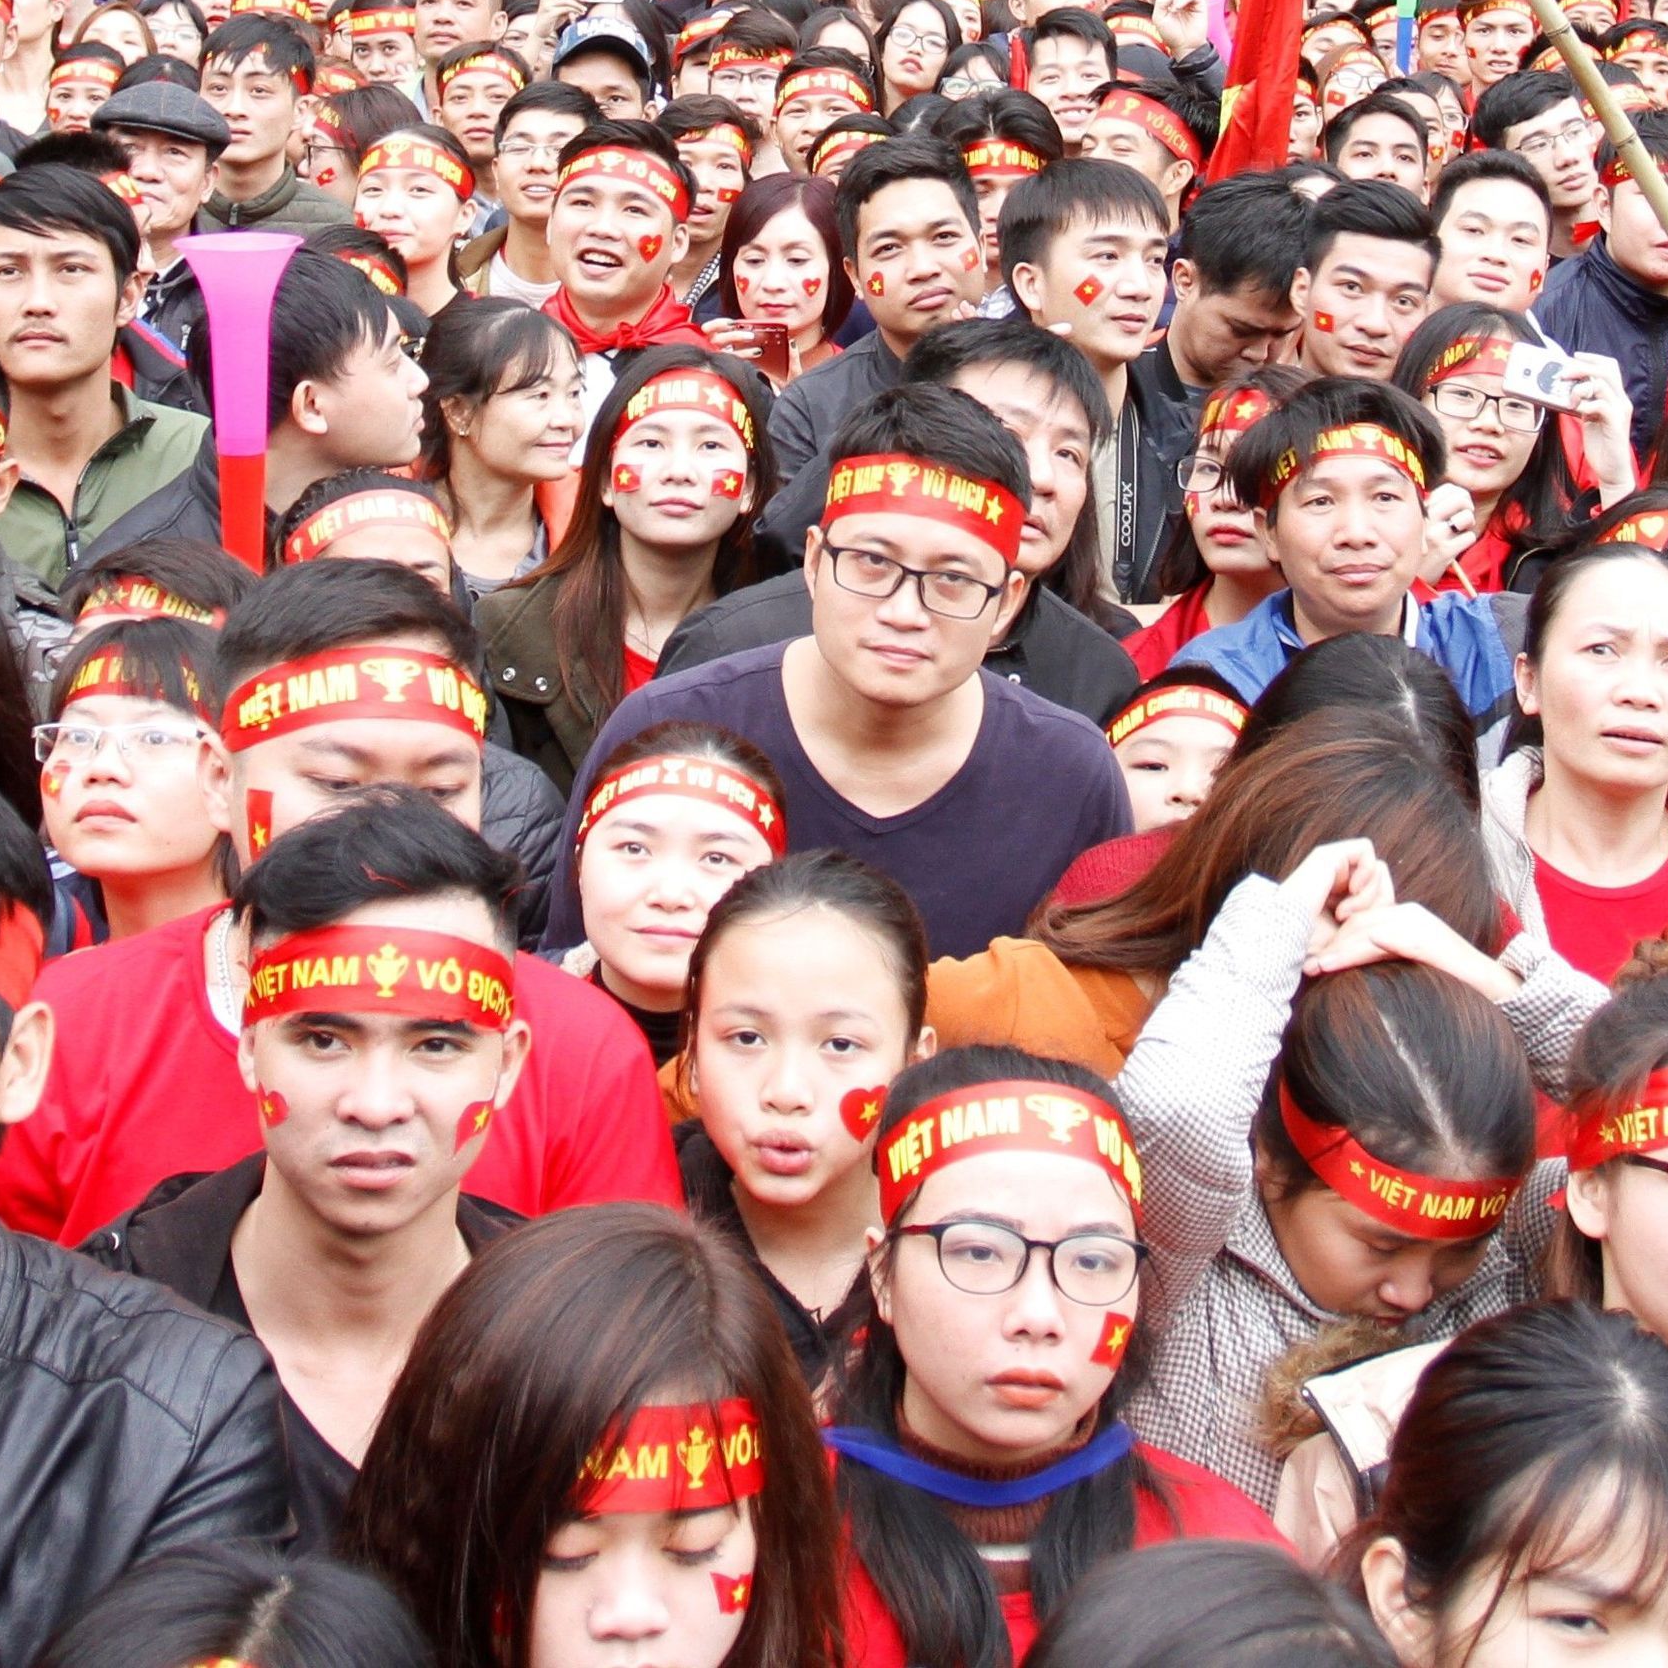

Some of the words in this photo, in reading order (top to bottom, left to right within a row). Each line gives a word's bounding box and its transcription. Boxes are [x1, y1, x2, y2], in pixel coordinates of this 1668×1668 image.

[1120, 480, 1133, 548] COOLPIX
[287, 664, 360, 713] NAM
[251, 956, 287, 1005] VIỆT
[291, 955, 360, 988] NAM
[416, 957, 464, 994] VÔ
[467, 971, 507, 1017] ĐỊCH
[888, 1110, 934, 1184] VIỆT
[940, 1097, 1021, 1149] NAM
[1615, 1103, 1663, 1149] VIỆT
[1369, 1167, 1417, 1210] VIỆT
[1419, 1192, 1477, 1224] NAM
[719, 1424, 753, 1471] VÔ
